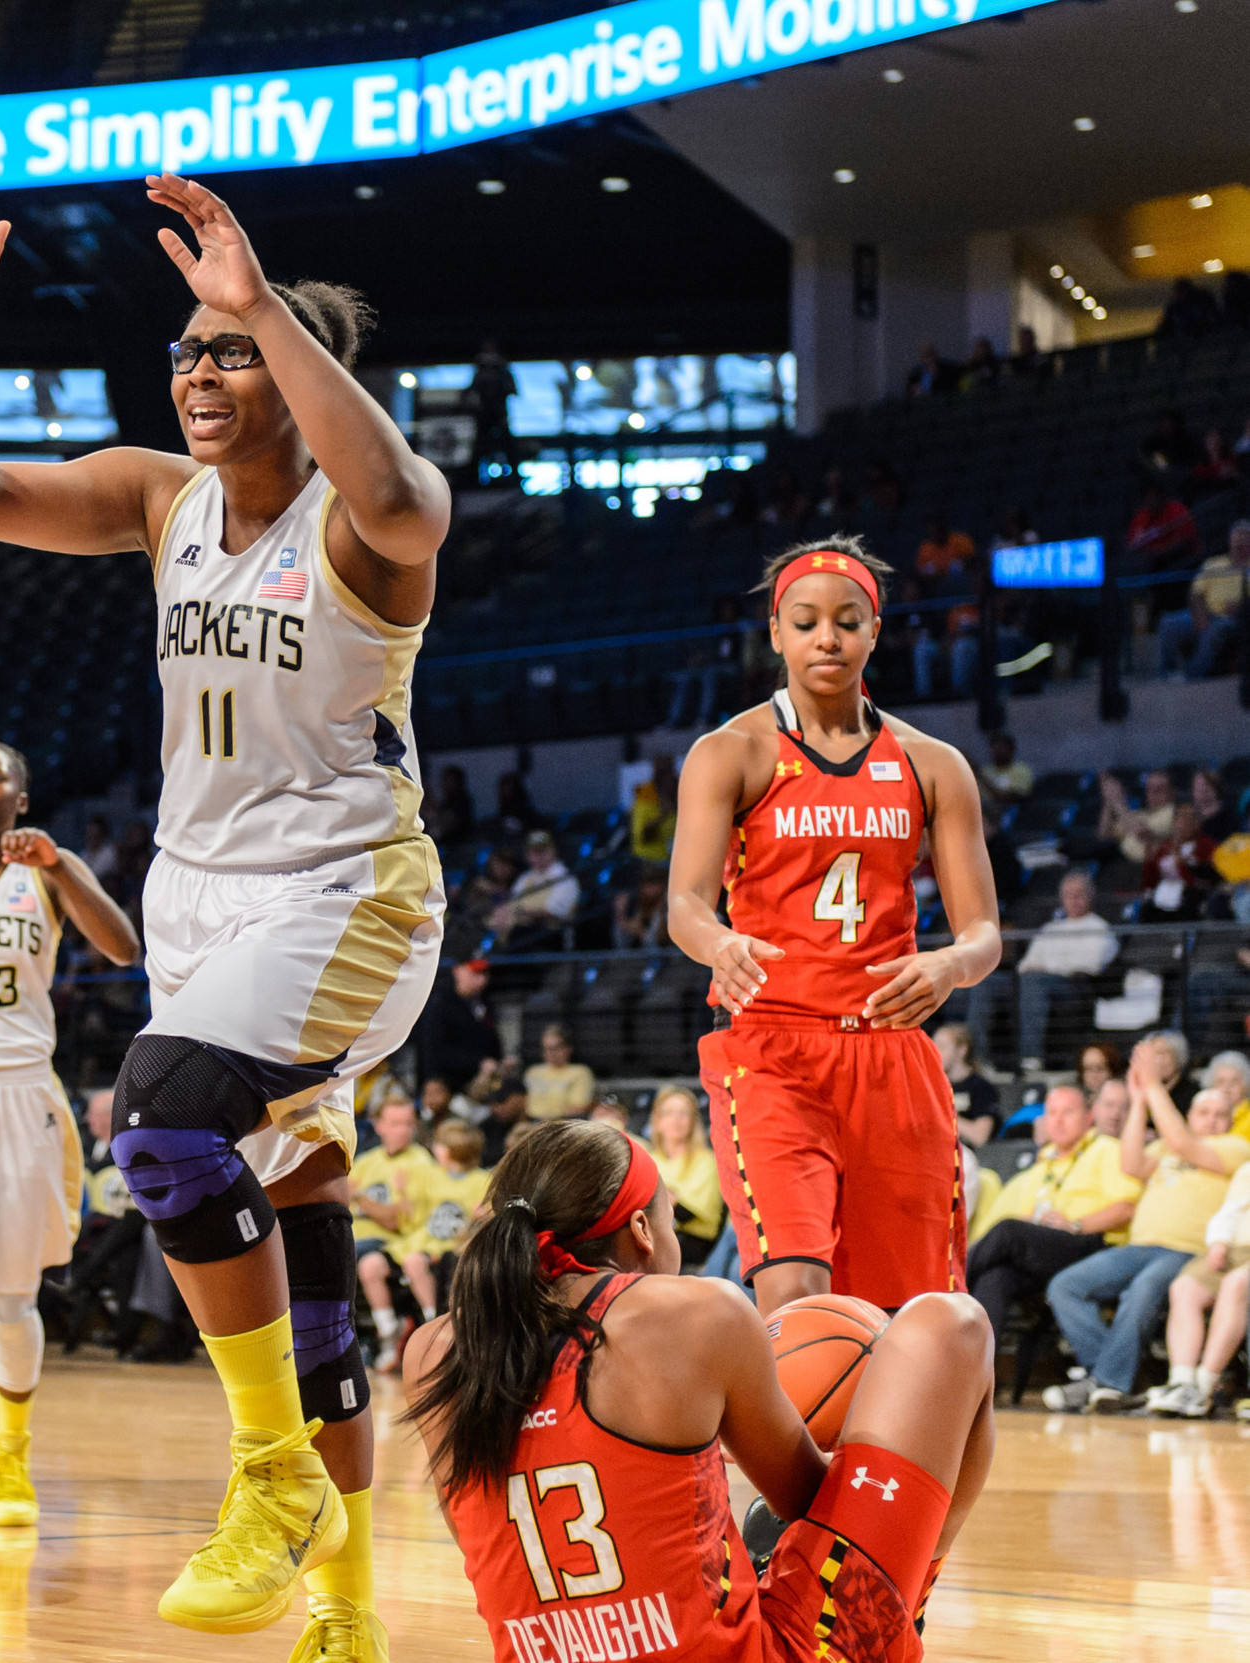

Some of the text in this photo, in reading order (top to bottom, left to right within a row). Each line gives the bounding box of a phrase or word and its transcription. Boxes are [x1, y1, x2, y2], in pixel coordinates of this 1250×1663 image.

[24, 78, 334, 176] Simplify
[351, 20, 682, 150] Enterprise
[698, 0, 978, 73] Mobi
[159, 600, 305, 672] JACKETS
[199, 686, 236, 761] 11
[775, 805, 911, 840] MARYLAND
[812, 852, 867, 944] 4
[520, 1409, 557, 1430] ACC
[507, 1461, 625, 1604] 13
[503, 1591, 679, 1663] DEVAUGHN
